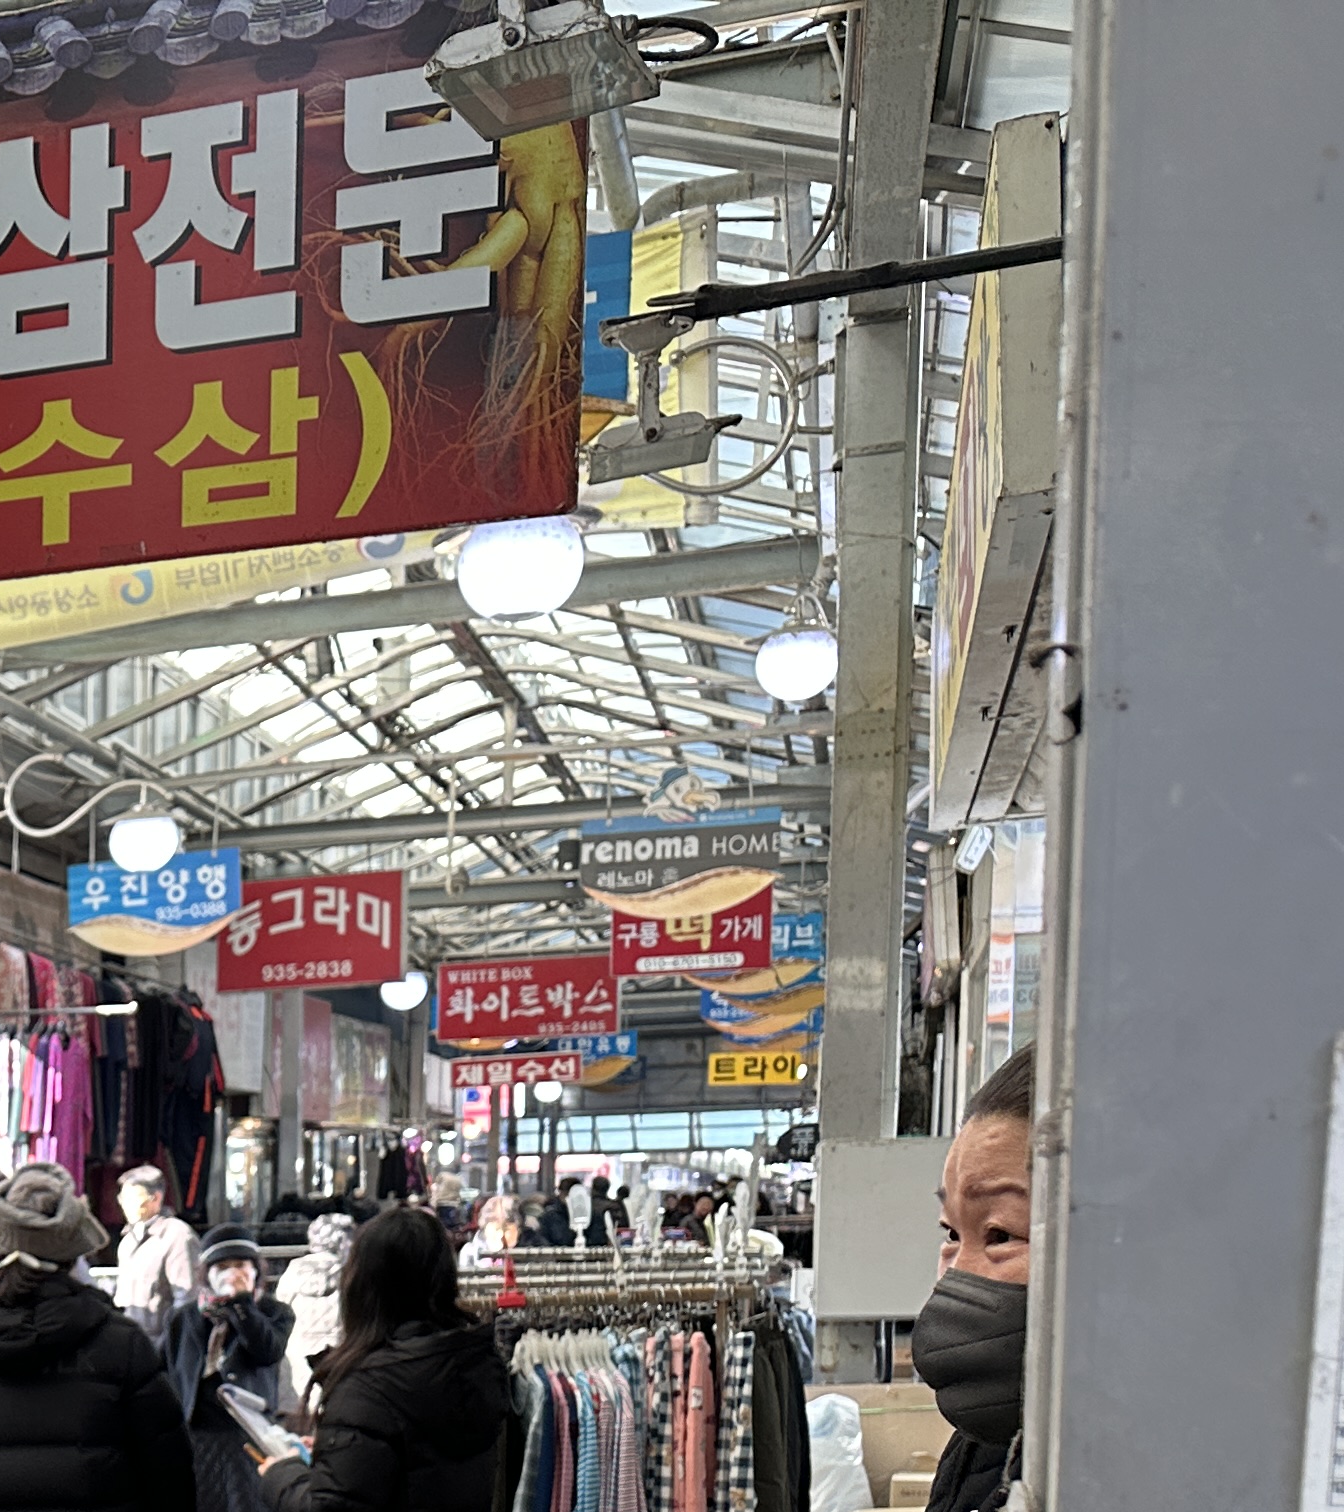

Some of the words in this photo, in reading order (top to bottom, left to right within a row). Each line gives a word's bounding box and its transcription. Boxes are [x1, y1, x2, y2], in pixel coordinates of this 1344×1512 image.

[581, 834, 700, 866] renoma
[712, 831, 782, 857] HOME
[81, 863, 227, 912] 우진양행
[597, 868, 654, 889] 레노마
[226, 885, 391, 957] 동그라미
[665, 912, 712, 952] 떡
[719, 914, 763, 943] 가게
[447, 967, 498, 985] WHITE
[500, 965, 534, 981] BOX
[445, 978, 614, 1025] 화이트박스
[455, 1057, 577, 1086] 제일수선
[713, 1054, 797, 1082] 트라이
